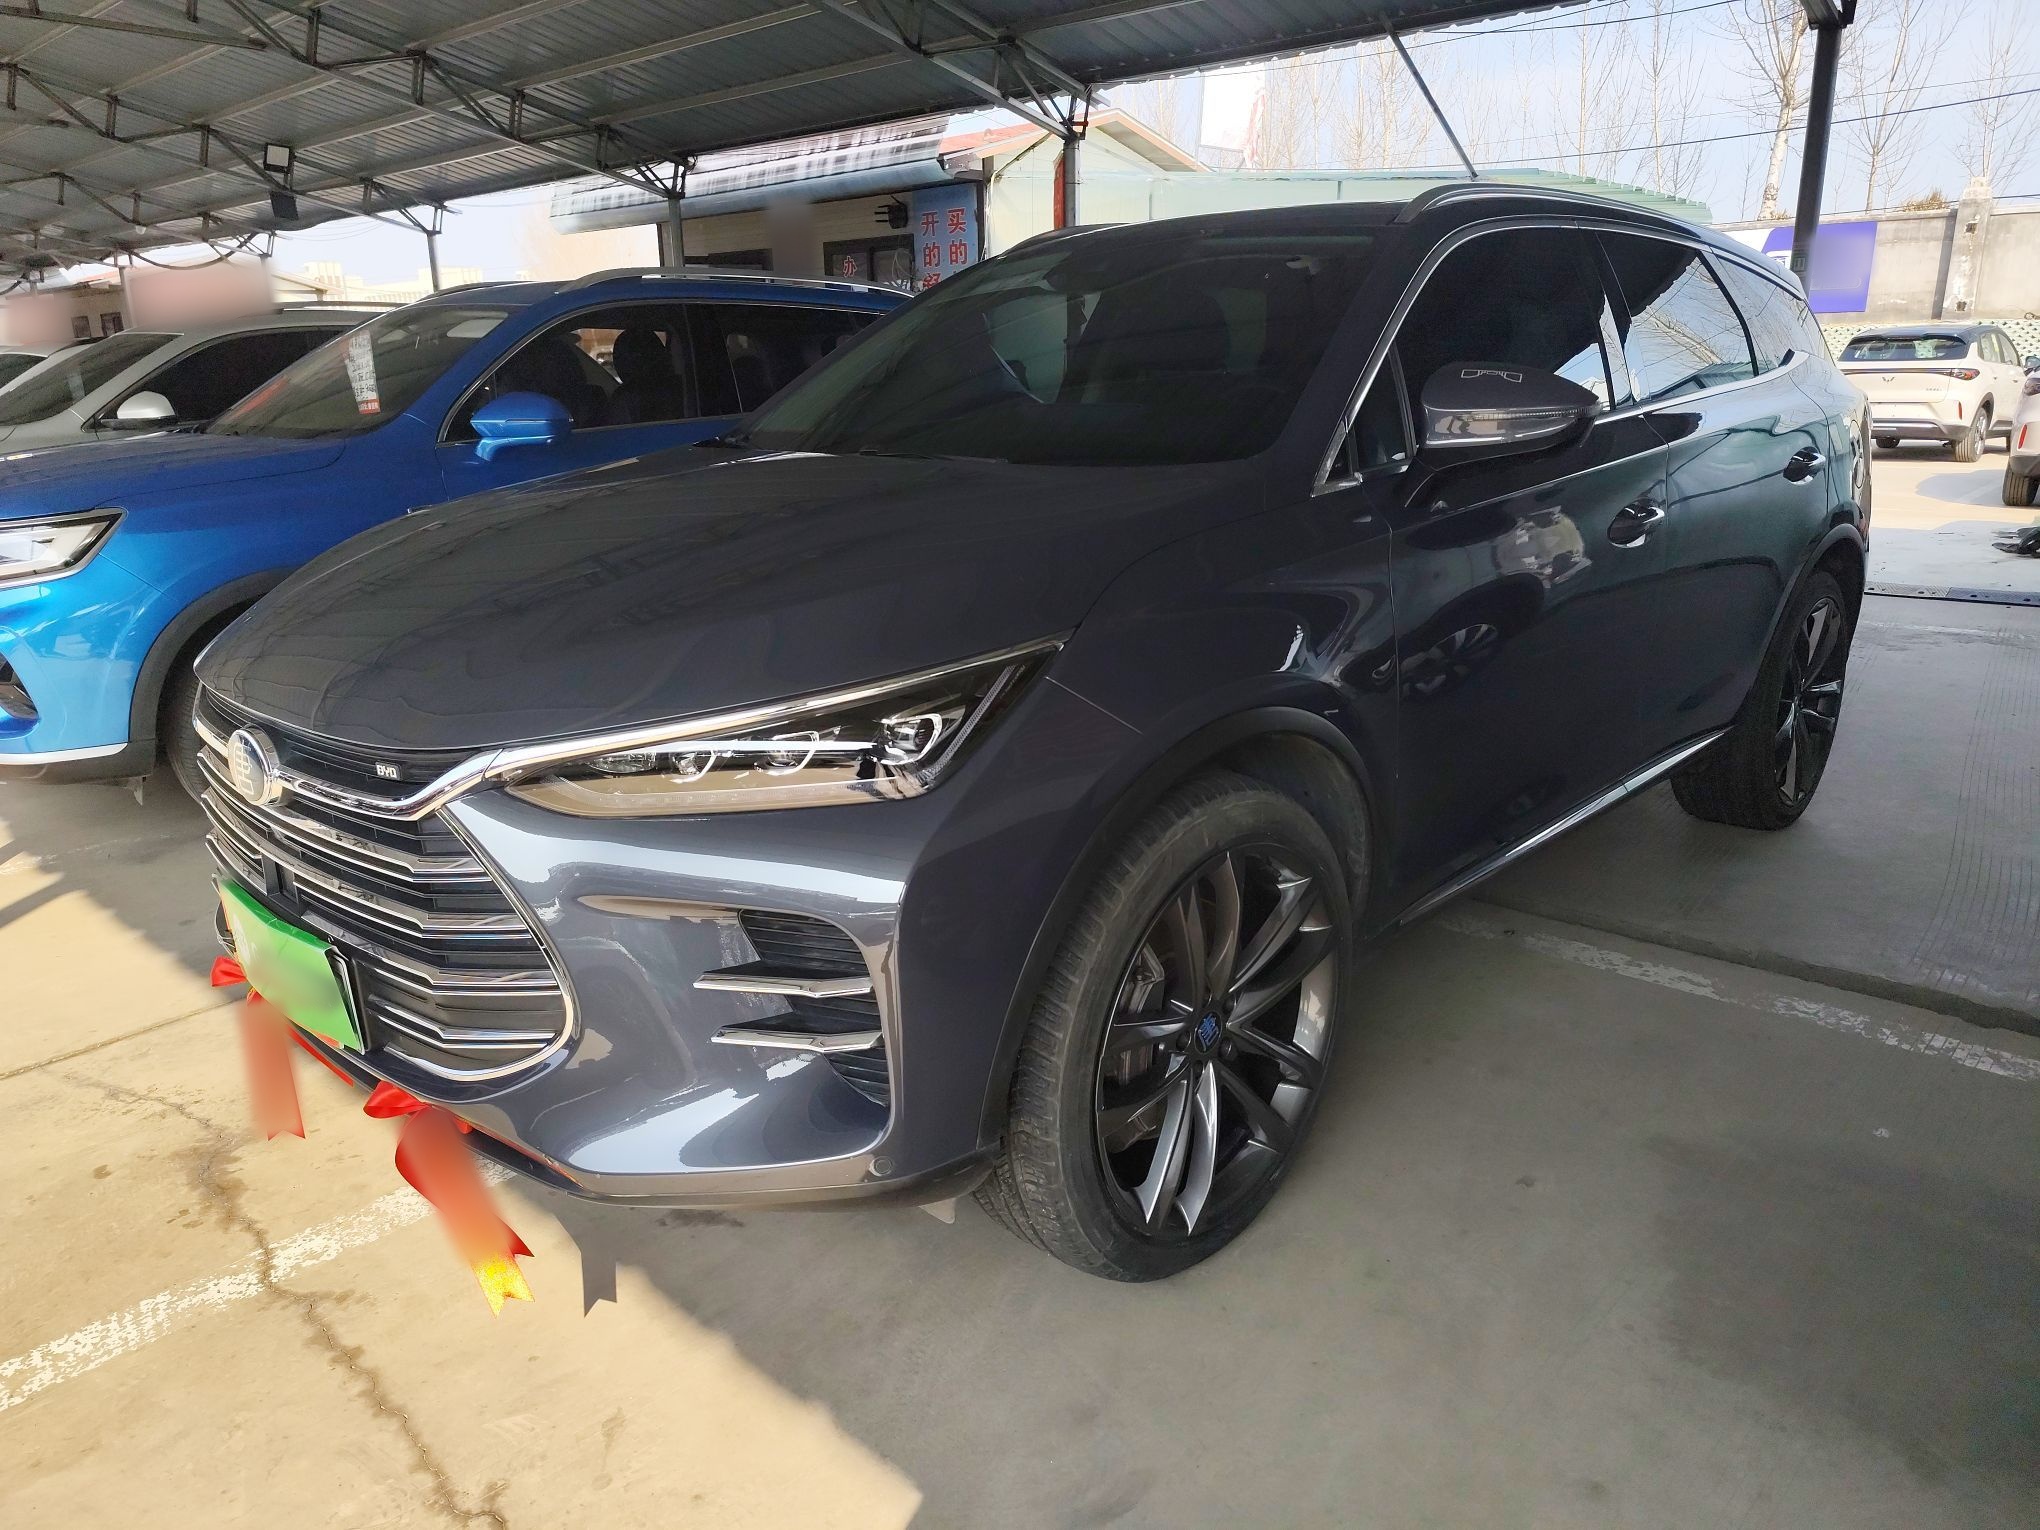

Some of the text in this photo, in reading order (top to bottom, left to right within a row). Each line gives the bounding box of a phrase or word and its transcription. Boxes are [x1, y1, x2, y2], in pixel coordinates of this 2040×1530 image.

[947, 206, 968, 273] 买的
[843, 255, 857, 278] 办
[376, 764, 398, 779] BYD
